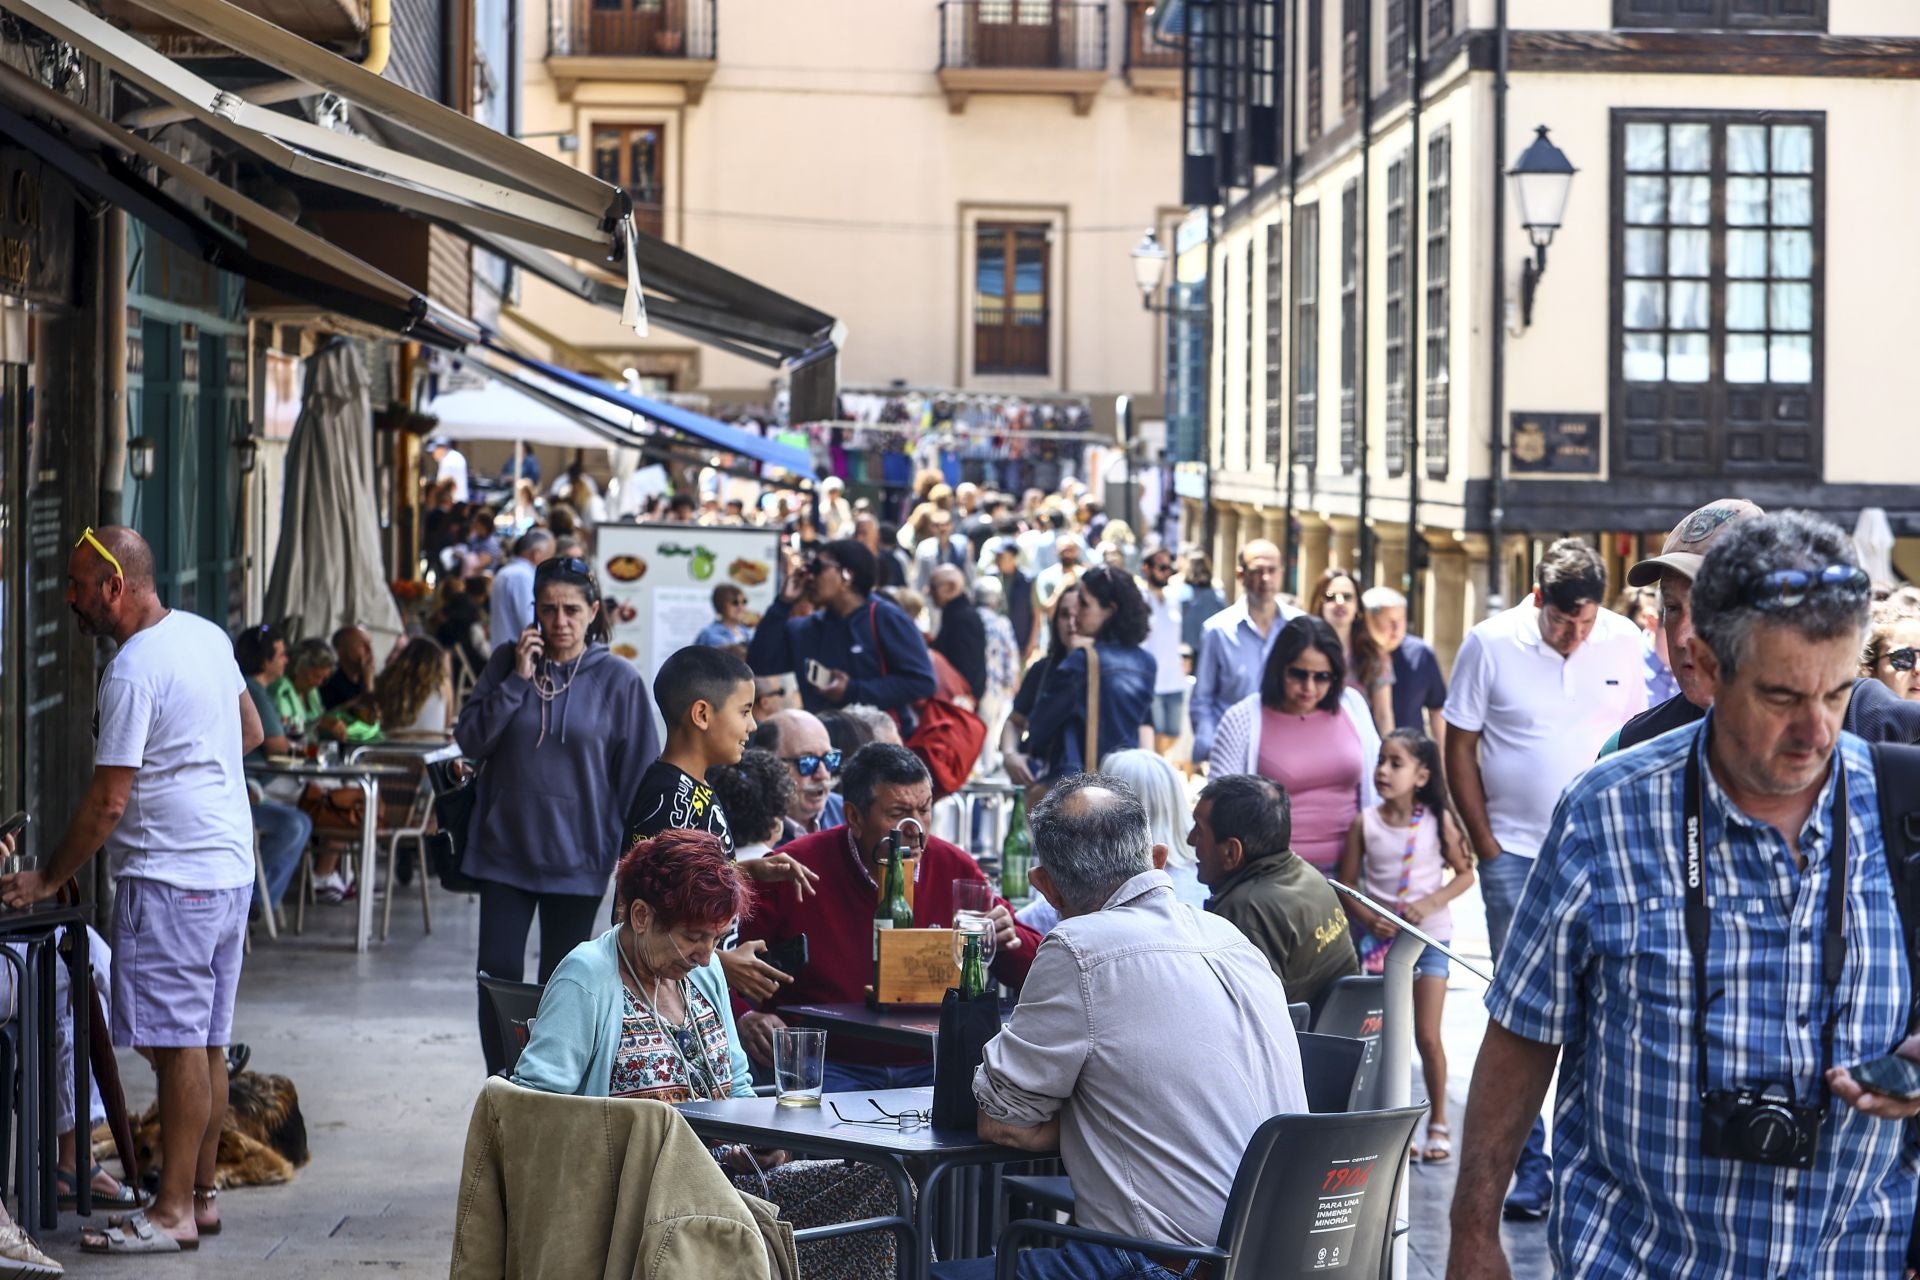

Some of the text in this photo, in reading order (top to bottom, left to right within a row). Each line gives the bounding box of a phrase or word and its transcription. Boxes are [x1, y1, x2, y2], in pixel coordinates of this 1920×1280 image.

[1687, 816, 1700, 888] OLYMPUS
[1321, 1162, 1376, 1193] 1906
[1318, 1198, 1360, 1210] PARA UNA
[1316, 1207, 1352, 1219] INMENSA
[1314, 1216, 1348, 1227] MINORÍA
